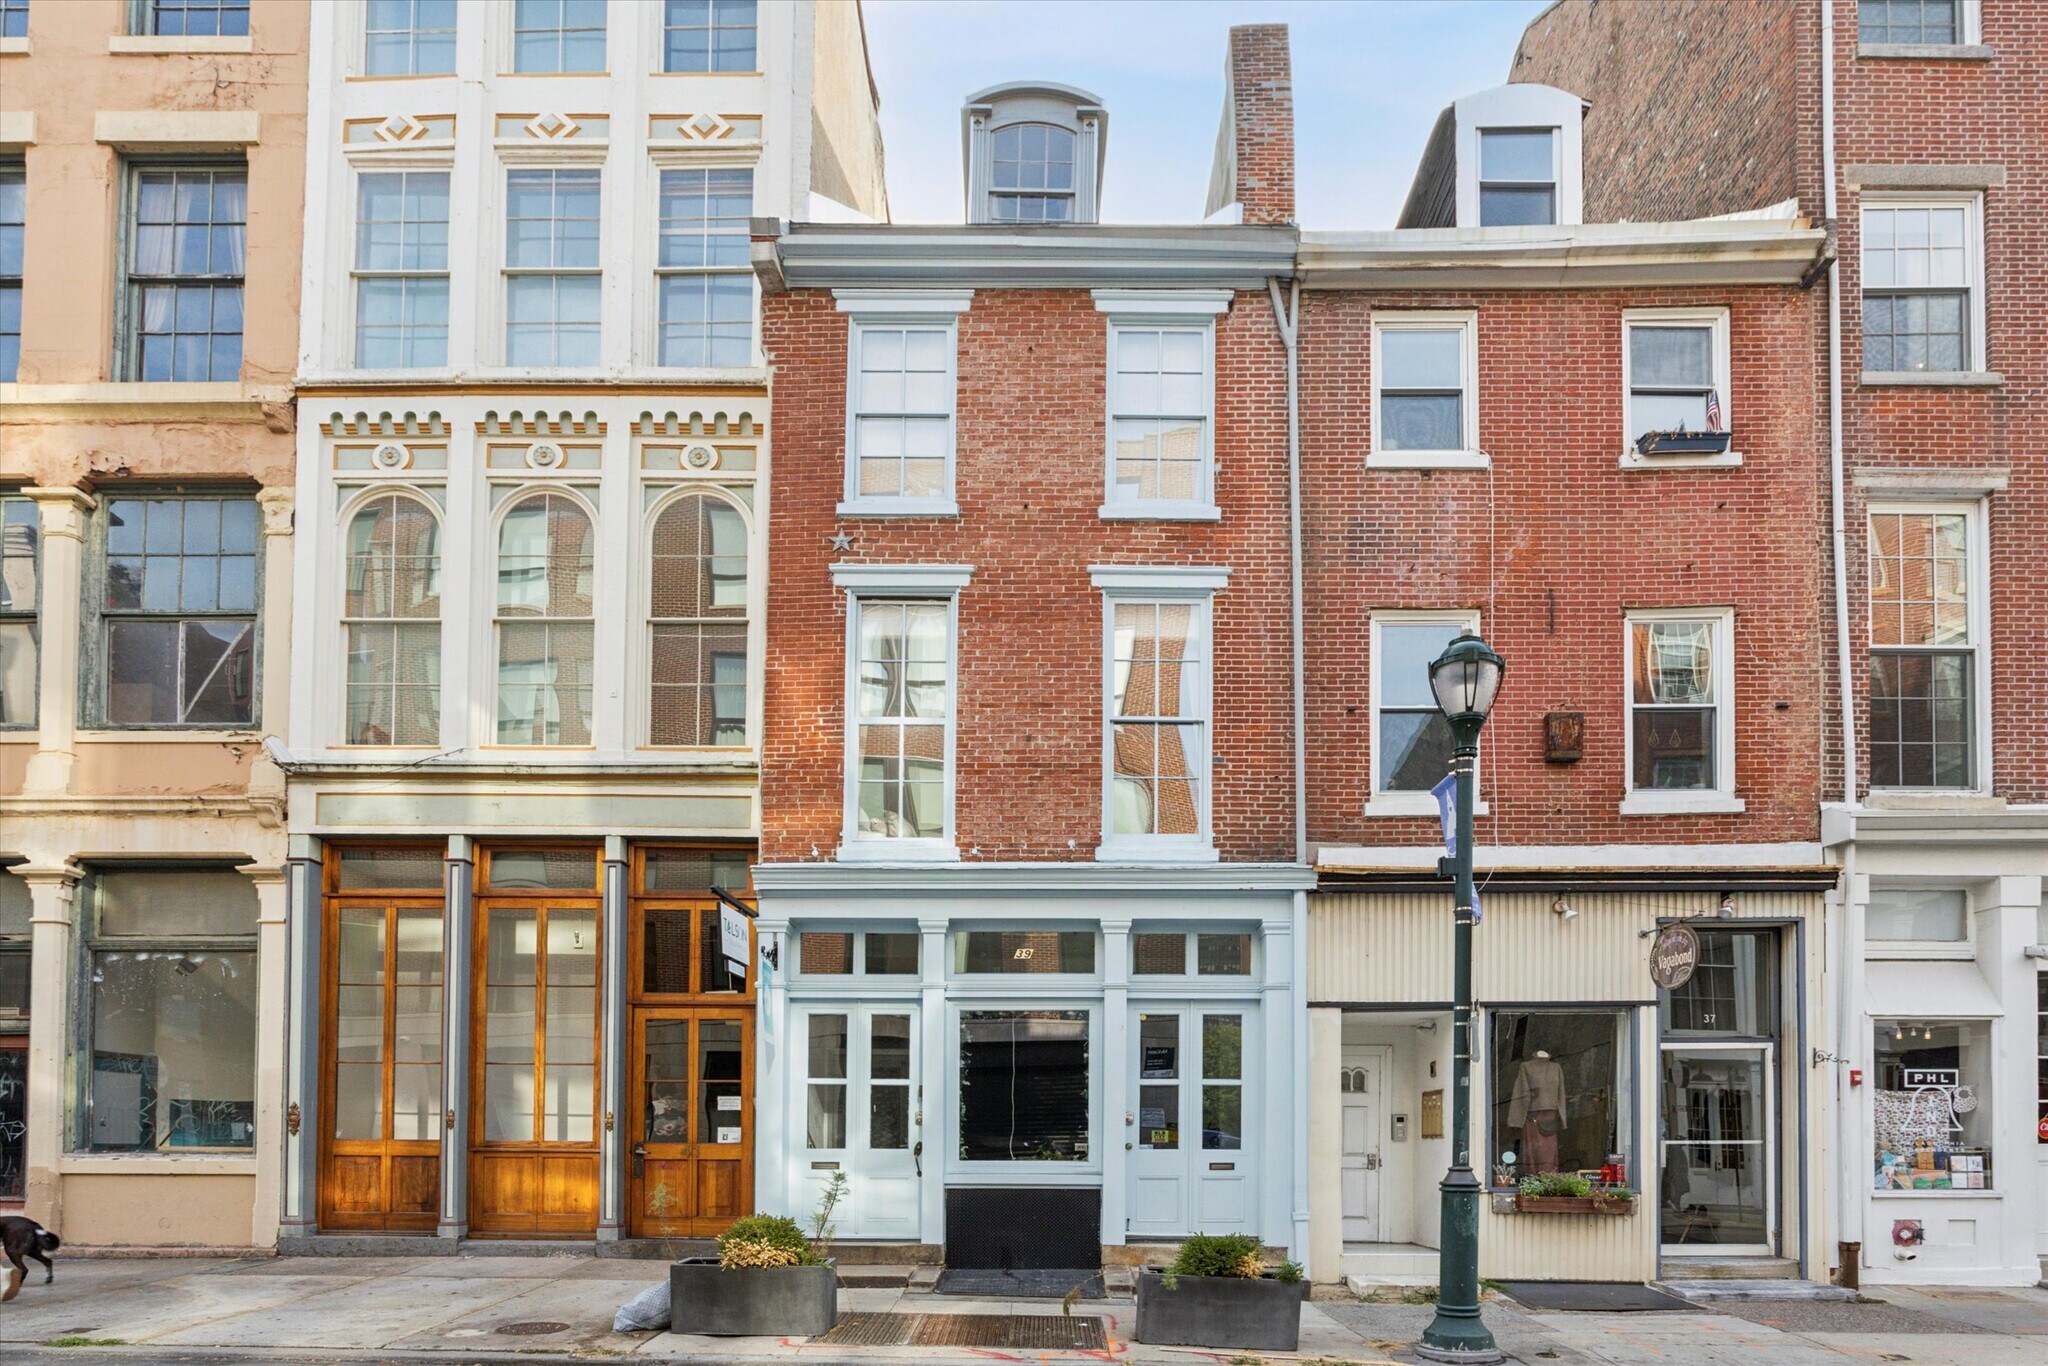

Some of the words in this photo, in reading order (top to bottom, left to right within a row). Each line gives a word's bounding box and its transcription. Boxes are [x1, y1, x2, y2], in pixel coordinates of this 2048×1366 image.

[1015, 949, 1032, 958] 39
[1658, 948, 1692, 975] Vagabond
[1703, 1014, 1716, 1023] 37
[1914, 1073, 1949, 1083] PHL
